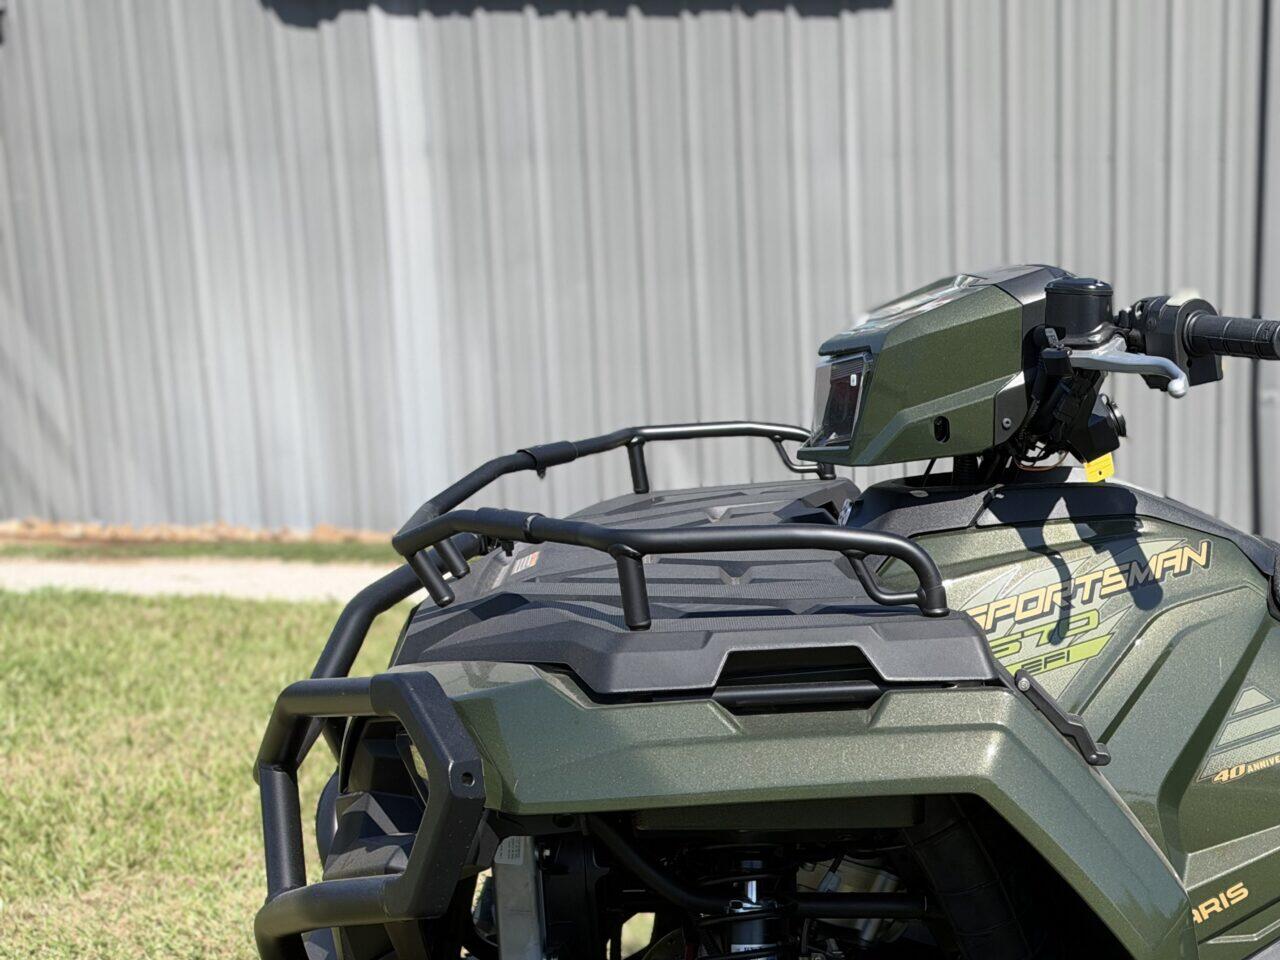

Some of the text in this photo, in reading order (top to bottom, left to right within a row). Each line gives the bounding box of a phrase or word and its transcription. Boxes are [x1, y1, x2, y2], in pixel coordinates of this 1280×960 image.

[966, 540, 1212, 635] SPORTSMAN
[1021, 648, 1071, 674] EFI
[1212, 763, 1246, 783] 40
